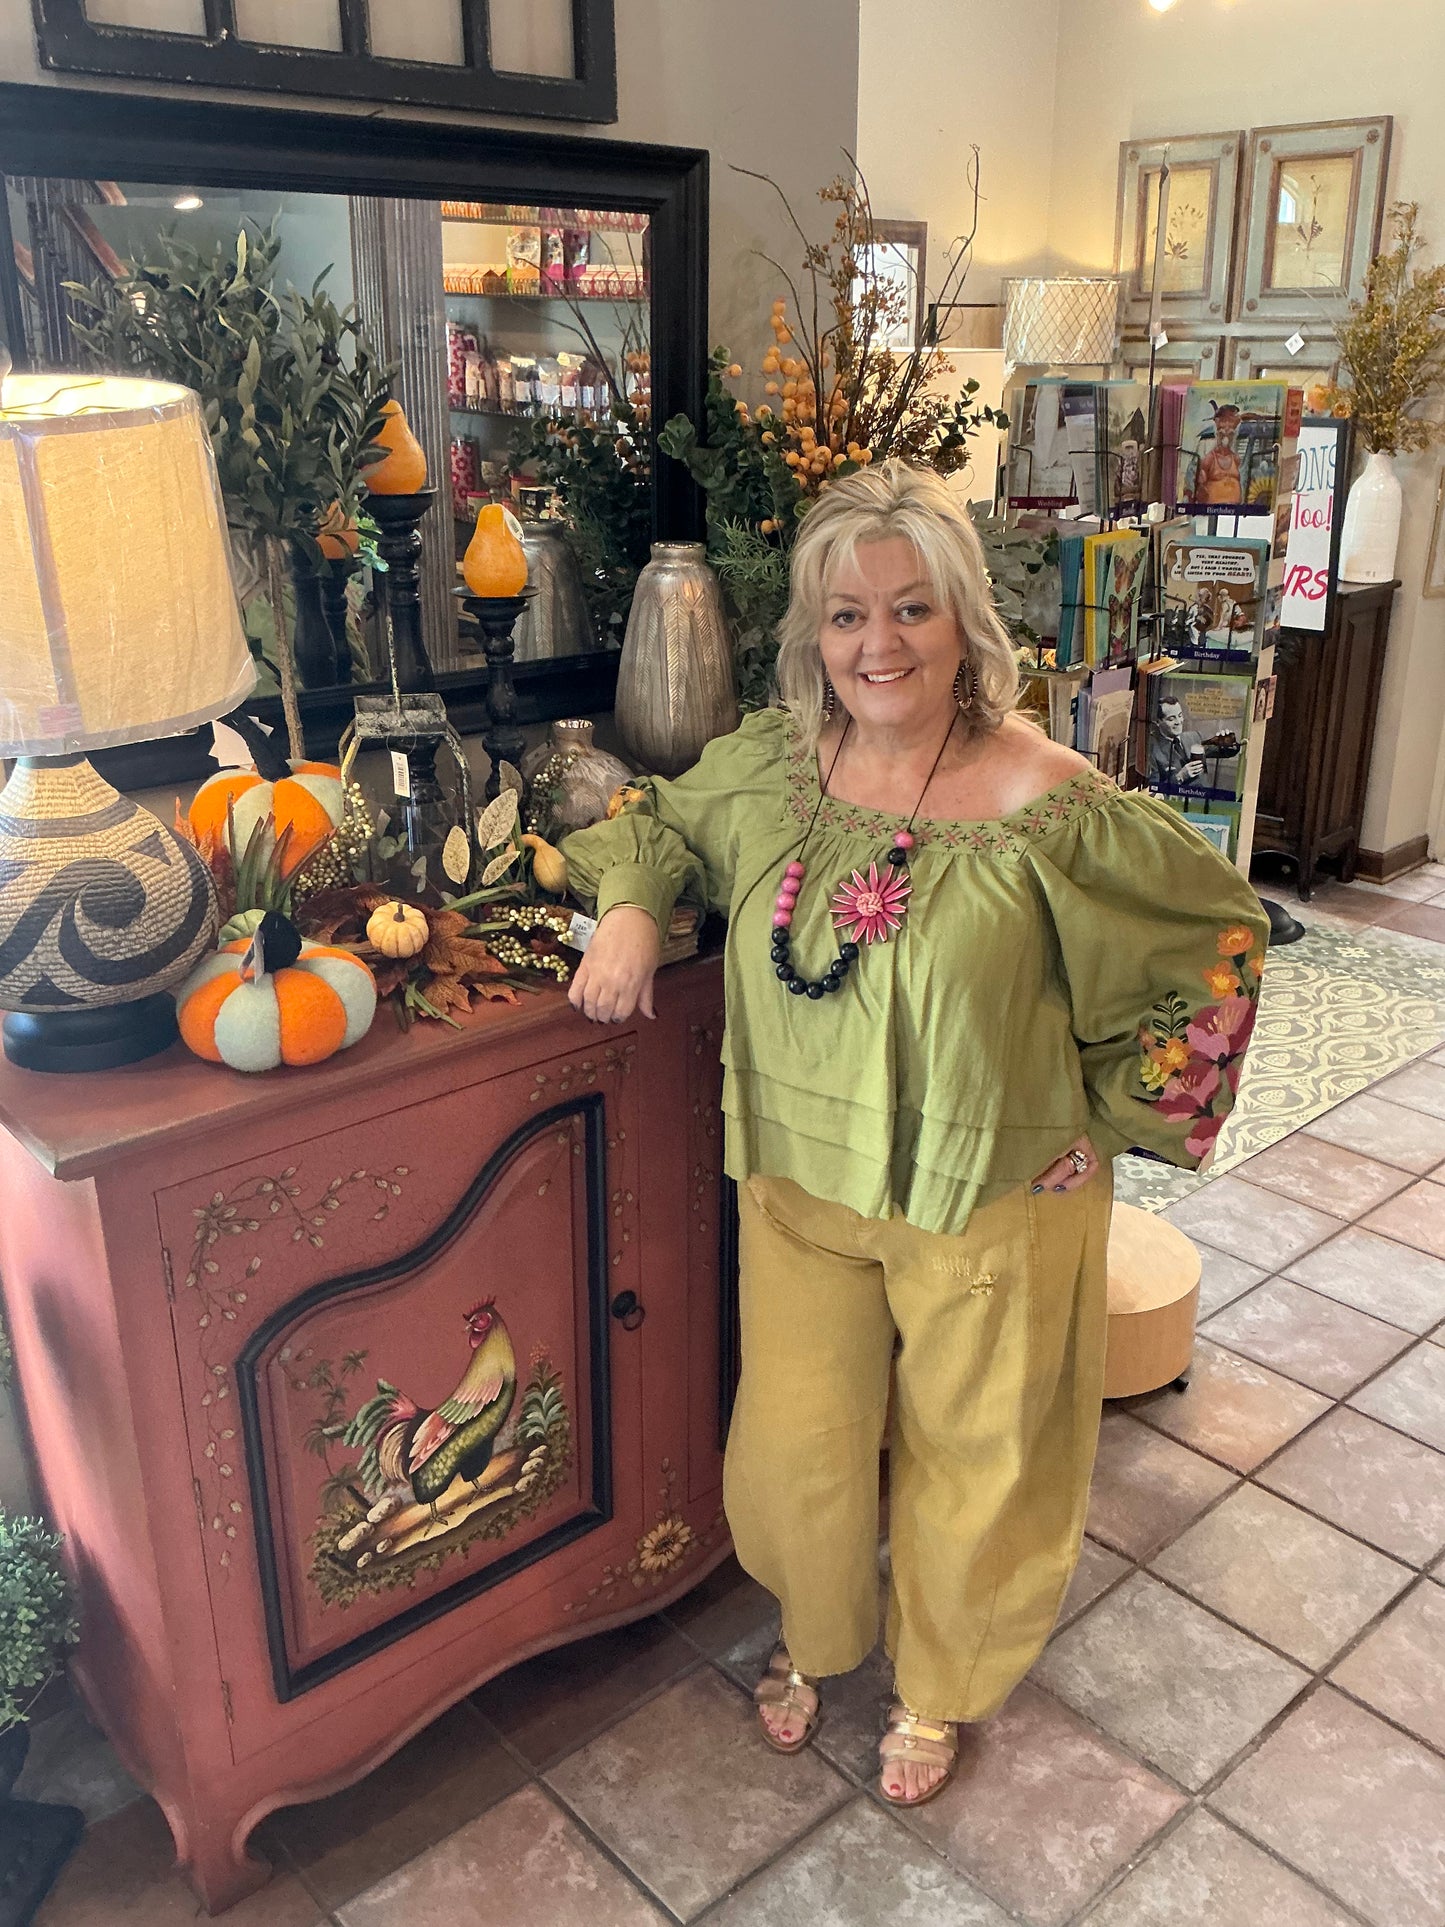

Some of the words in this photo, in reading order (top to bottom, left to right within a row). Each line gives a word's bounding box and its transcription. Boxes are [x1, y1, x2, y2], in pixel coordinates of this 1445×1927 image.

[1206, 506, 1235, 514] Birthday
[1292, 493, 1333, 532] Too!
[1194, 650, 1220, 660] Birthday
[1178, 787, 1207, 797] Birthday
